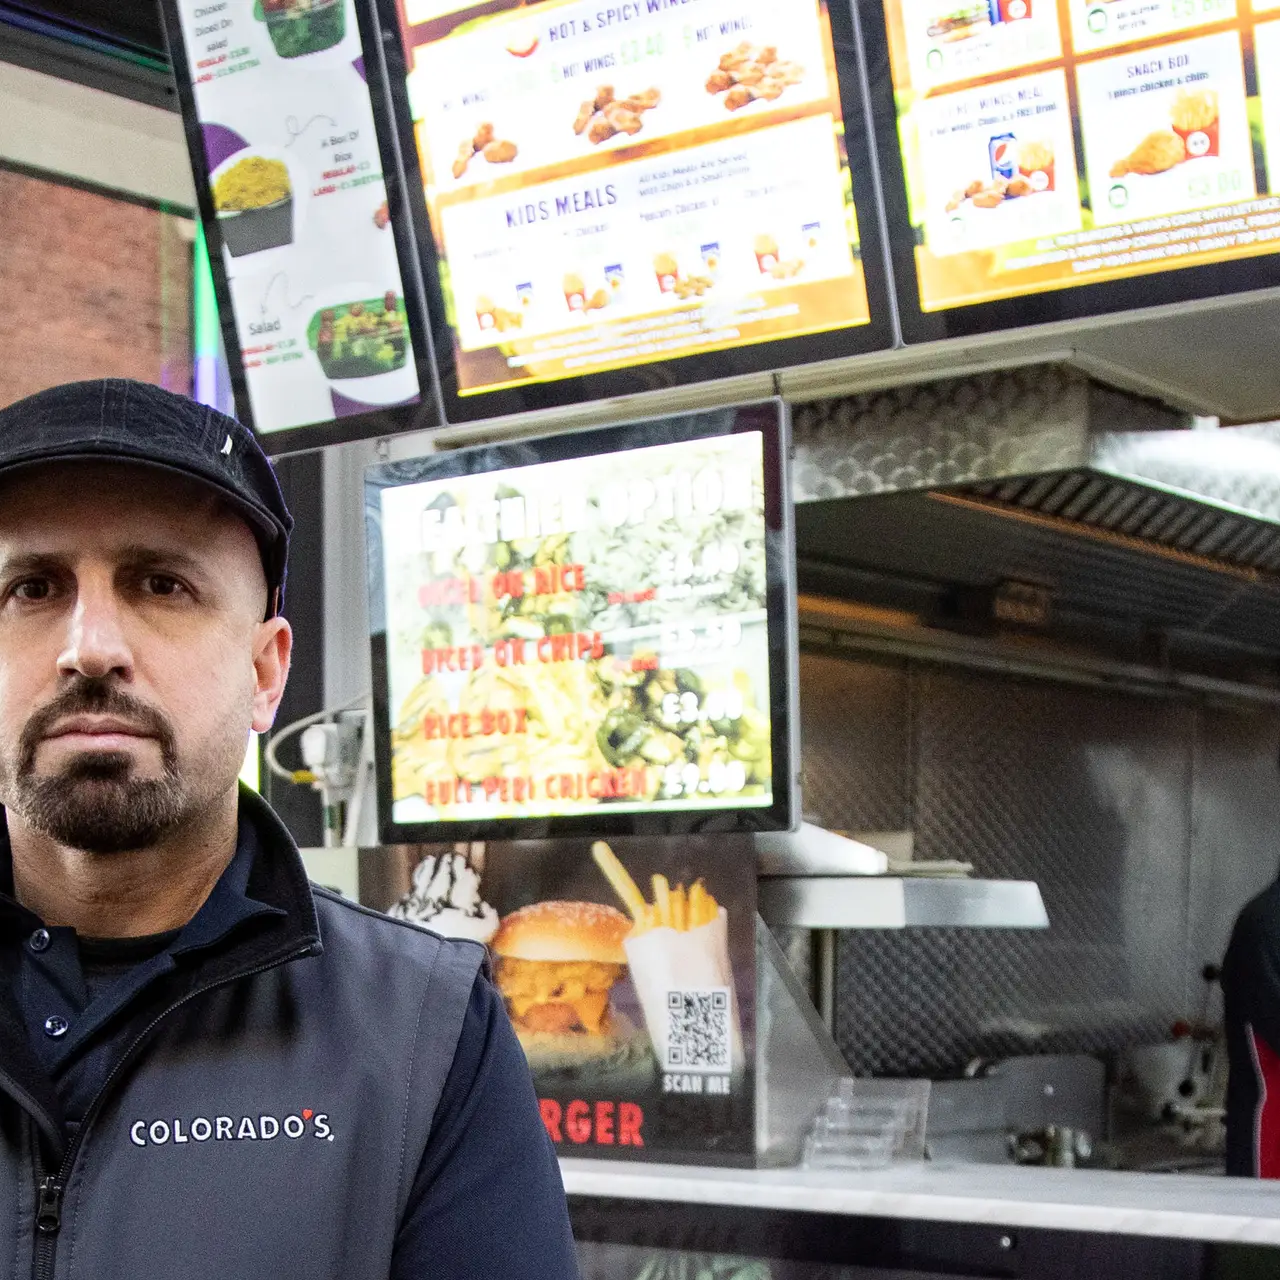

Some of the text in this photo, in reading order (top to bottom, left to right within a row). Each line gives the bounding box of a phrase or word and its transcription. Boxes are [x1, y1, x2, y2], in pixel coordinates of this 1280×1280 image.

[548, 19, 577, 42] HOT
[596, 6, 642, 29] SPICY
[505, 183, 618, 228] KIDS MEALS
[248, 320, 281, 335] Salad
[492, 569, 524, 599] ON
[533, 564, 587, 596] RICE
[536, 631, 604, 664] CHIPS
[424, 712, 472, 740] RICE
[480, 707, 528, 736] BOX
[480, 774, 536, 805] PERI
[544, 766, 648, 802] CHICKEN
[663, 1073, 731, 1095] SCAN ME
